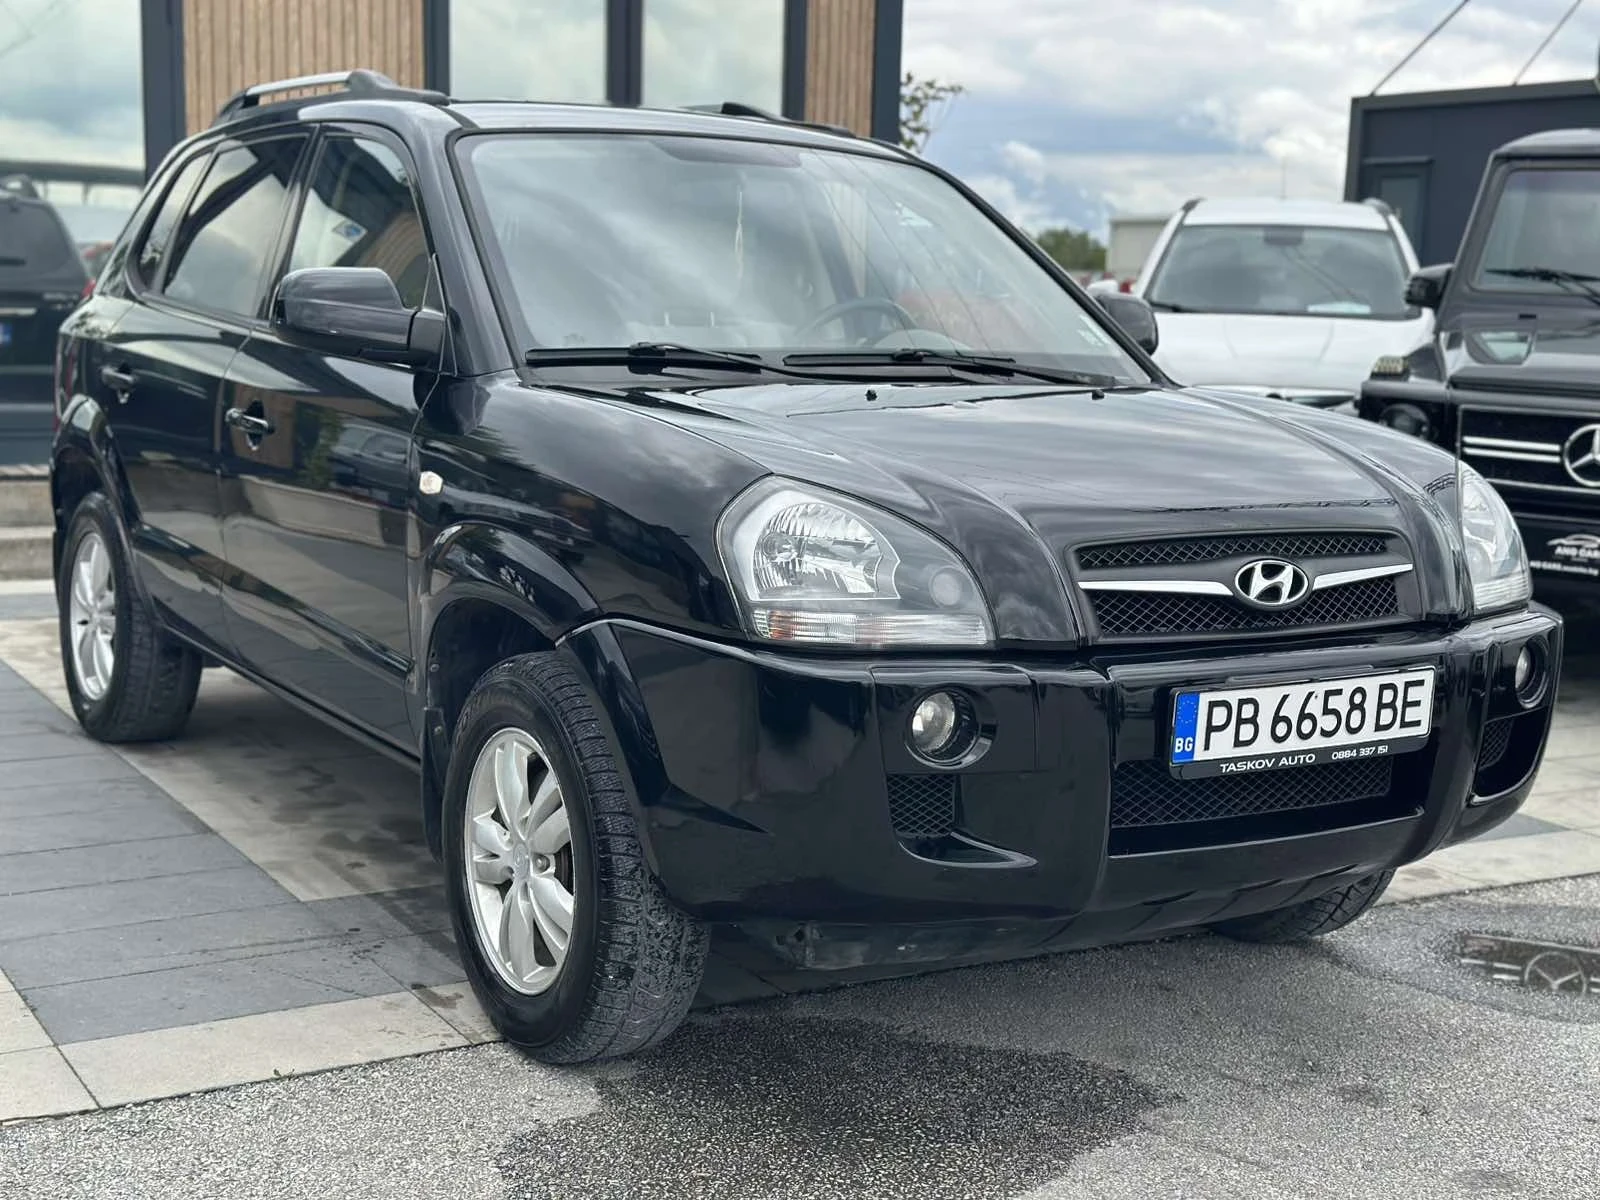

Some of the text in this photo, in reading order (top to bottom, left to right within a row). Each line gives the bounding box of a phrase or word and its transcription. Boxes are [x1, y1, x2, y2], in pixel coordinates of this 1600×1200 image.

[1203, 679, 1426, 751] PB 6658 BE
[1175, 737, 1194, 753] BG
[1220, 758, 1275, 774] TASKOV
[1278, 753, 1316, 767] AUTO
[1331, 748, 1357, 760] 0884
